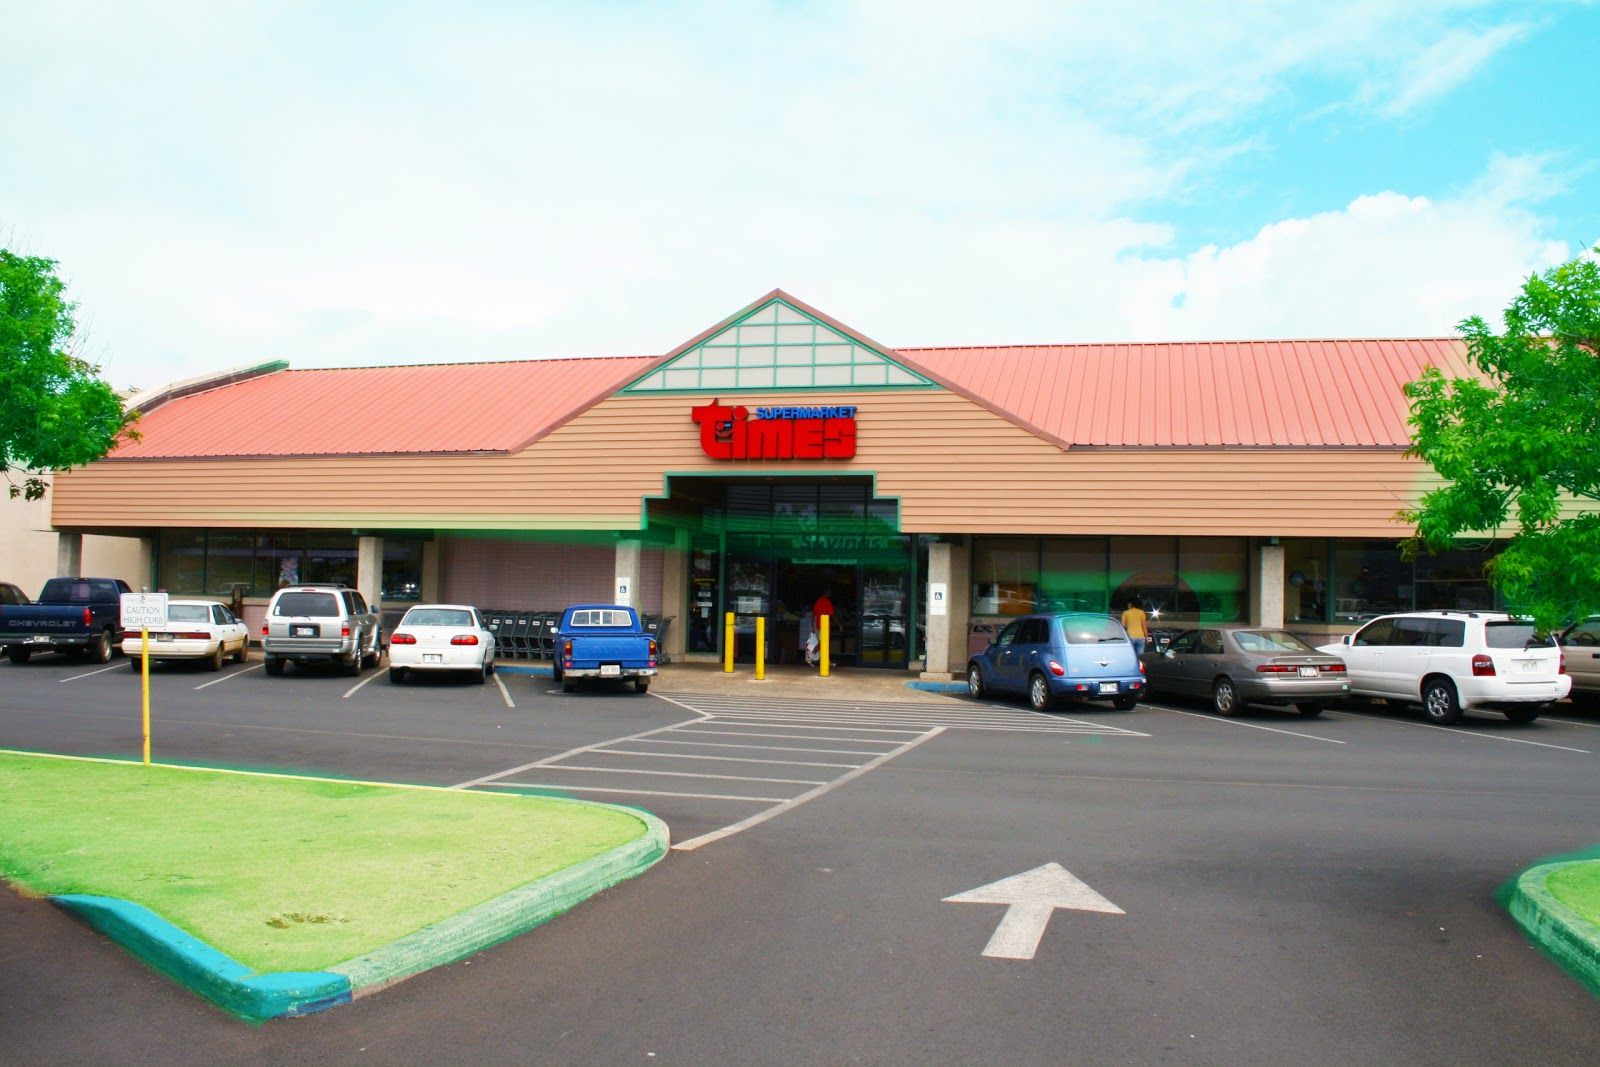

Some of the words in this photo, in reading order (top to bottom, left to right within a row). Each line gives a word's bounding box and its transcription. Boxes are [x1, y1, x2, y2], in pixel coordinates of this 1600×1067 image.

[756, 406, 857, 420] SUPERMARKET
[126, 606, 160, 614] CAUTION
[8, 619, 78, 627] CHEVROLET
[123, 616, 142, 624] HIGH
[144, 616, 163, 624] CURB
